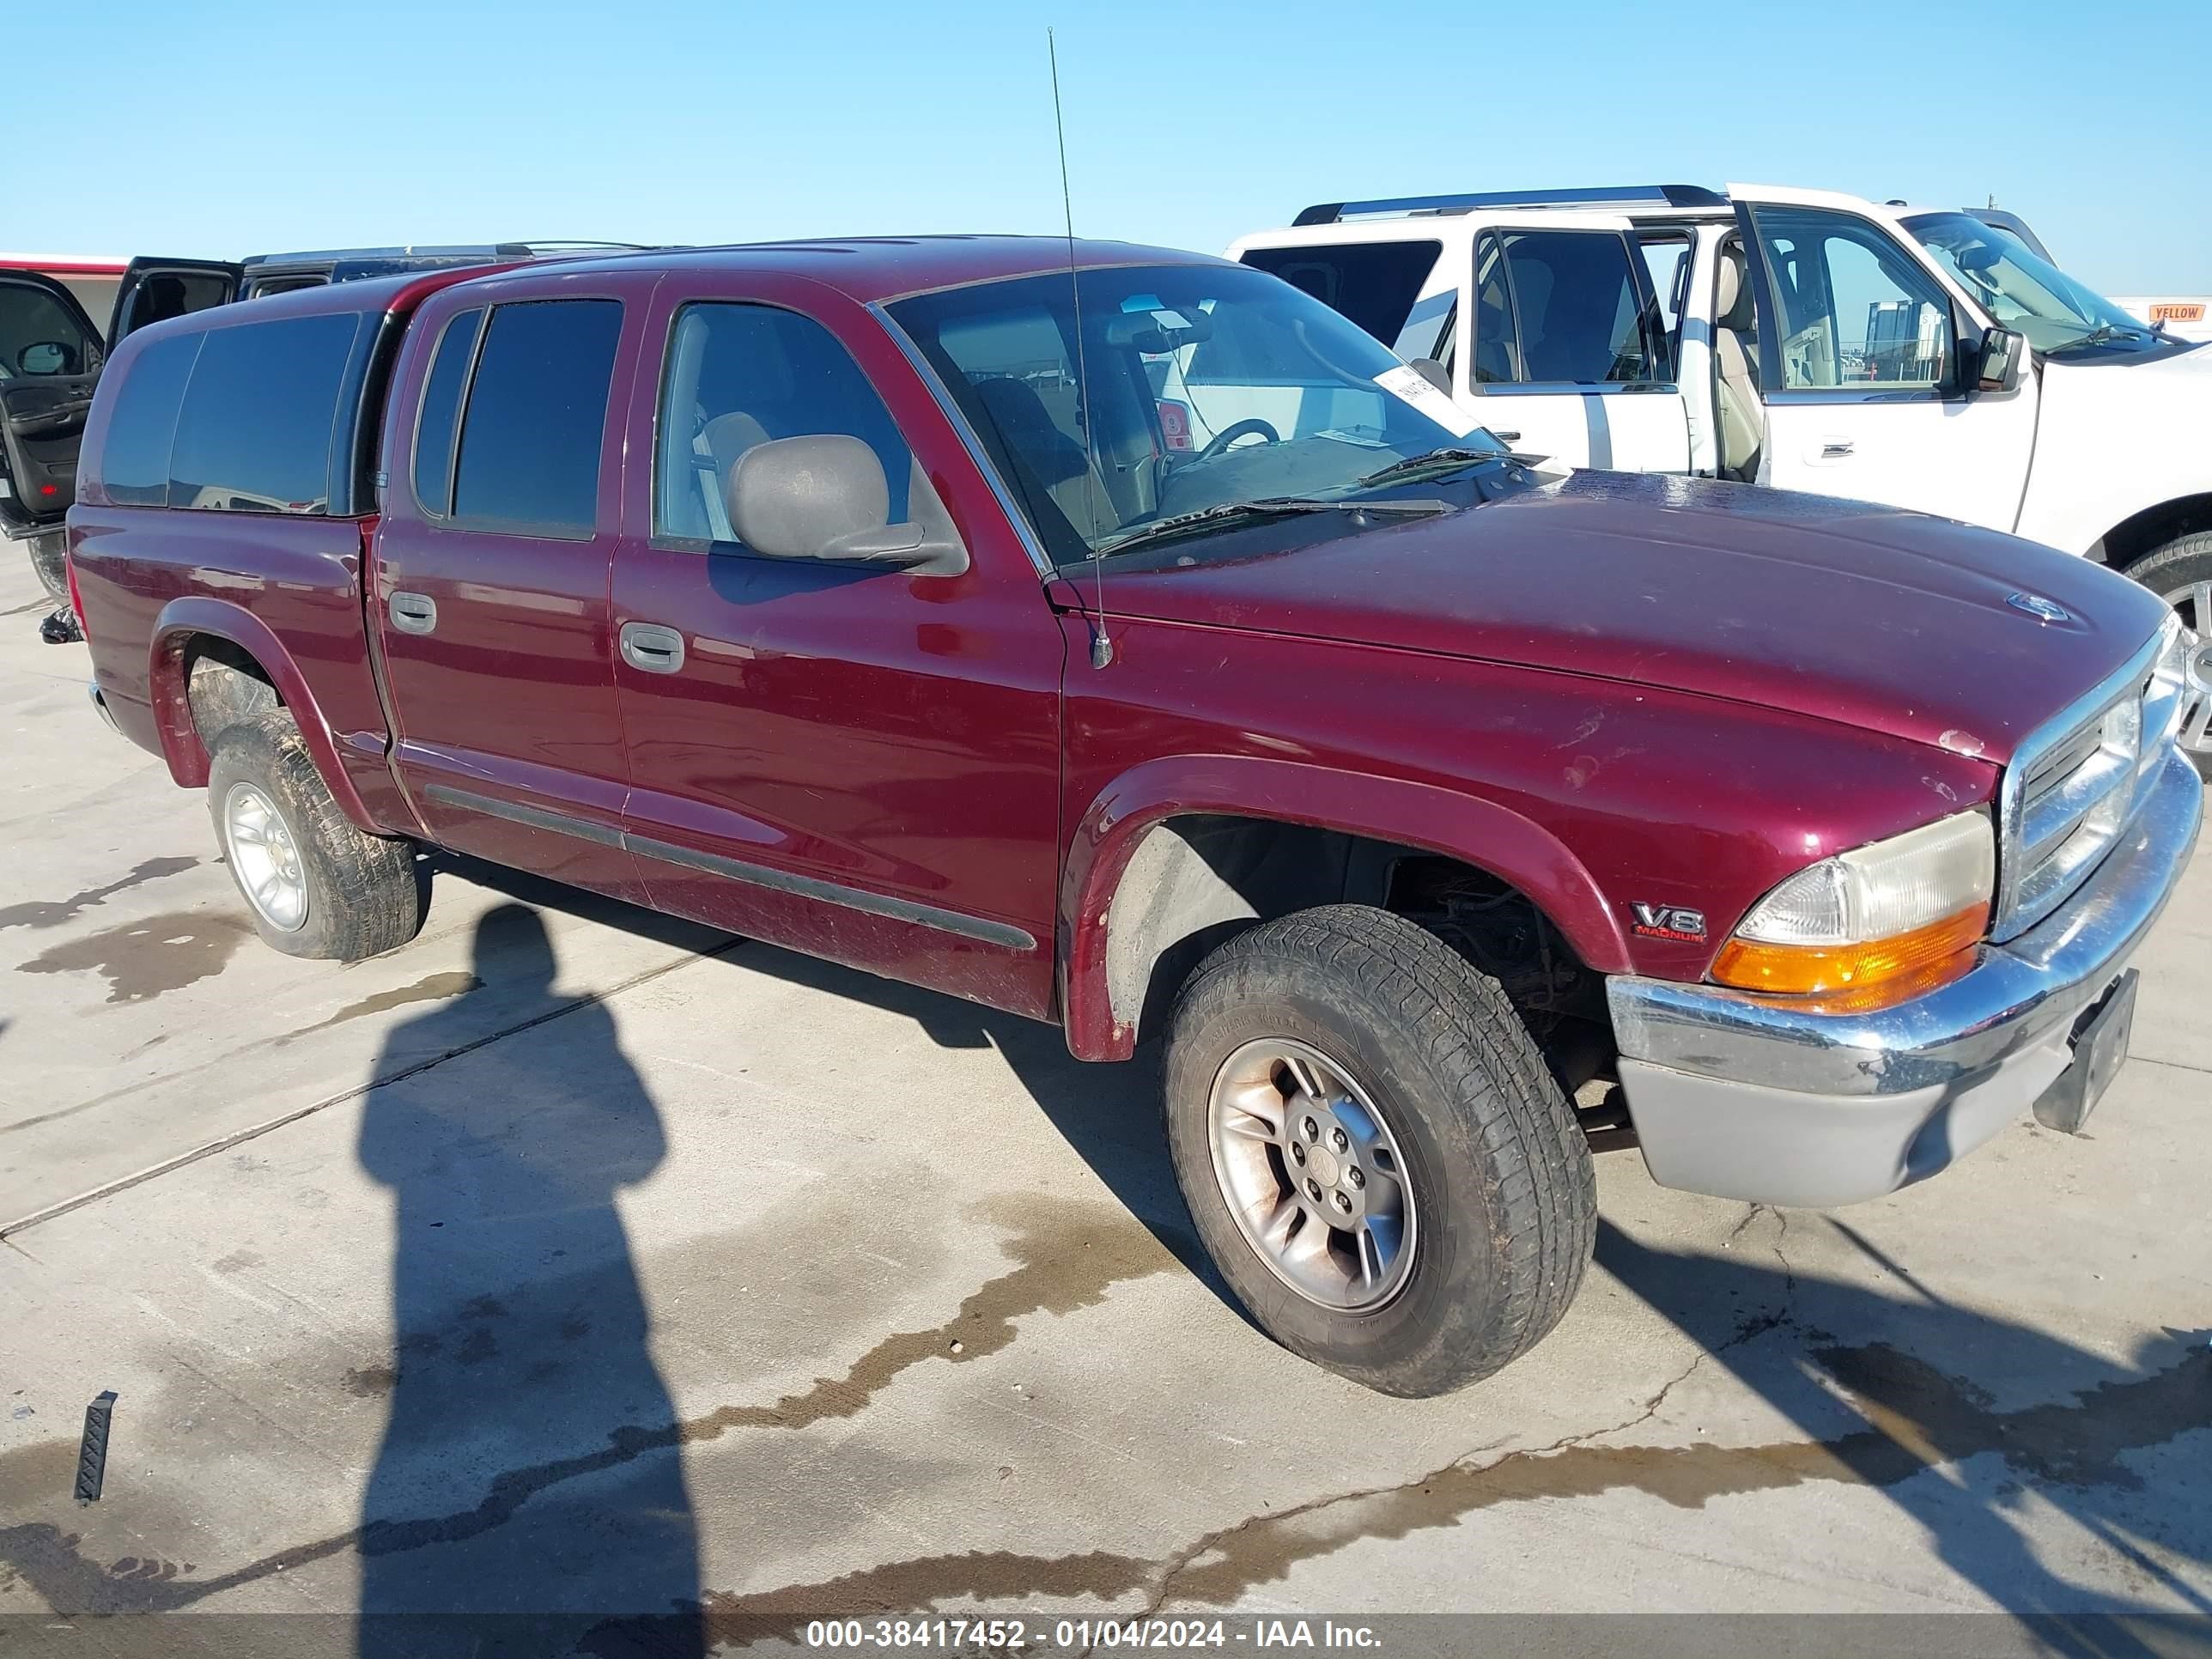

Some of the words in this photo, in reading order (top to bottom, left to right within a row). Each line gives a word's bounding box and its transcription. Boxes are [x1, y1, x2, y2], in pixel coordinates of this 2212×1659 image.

[2155, 307, 2199, 319] YELLOW
[1631, 902, 1705, 934] V8
[1635, 926, 1705, 944] MAGNUM
